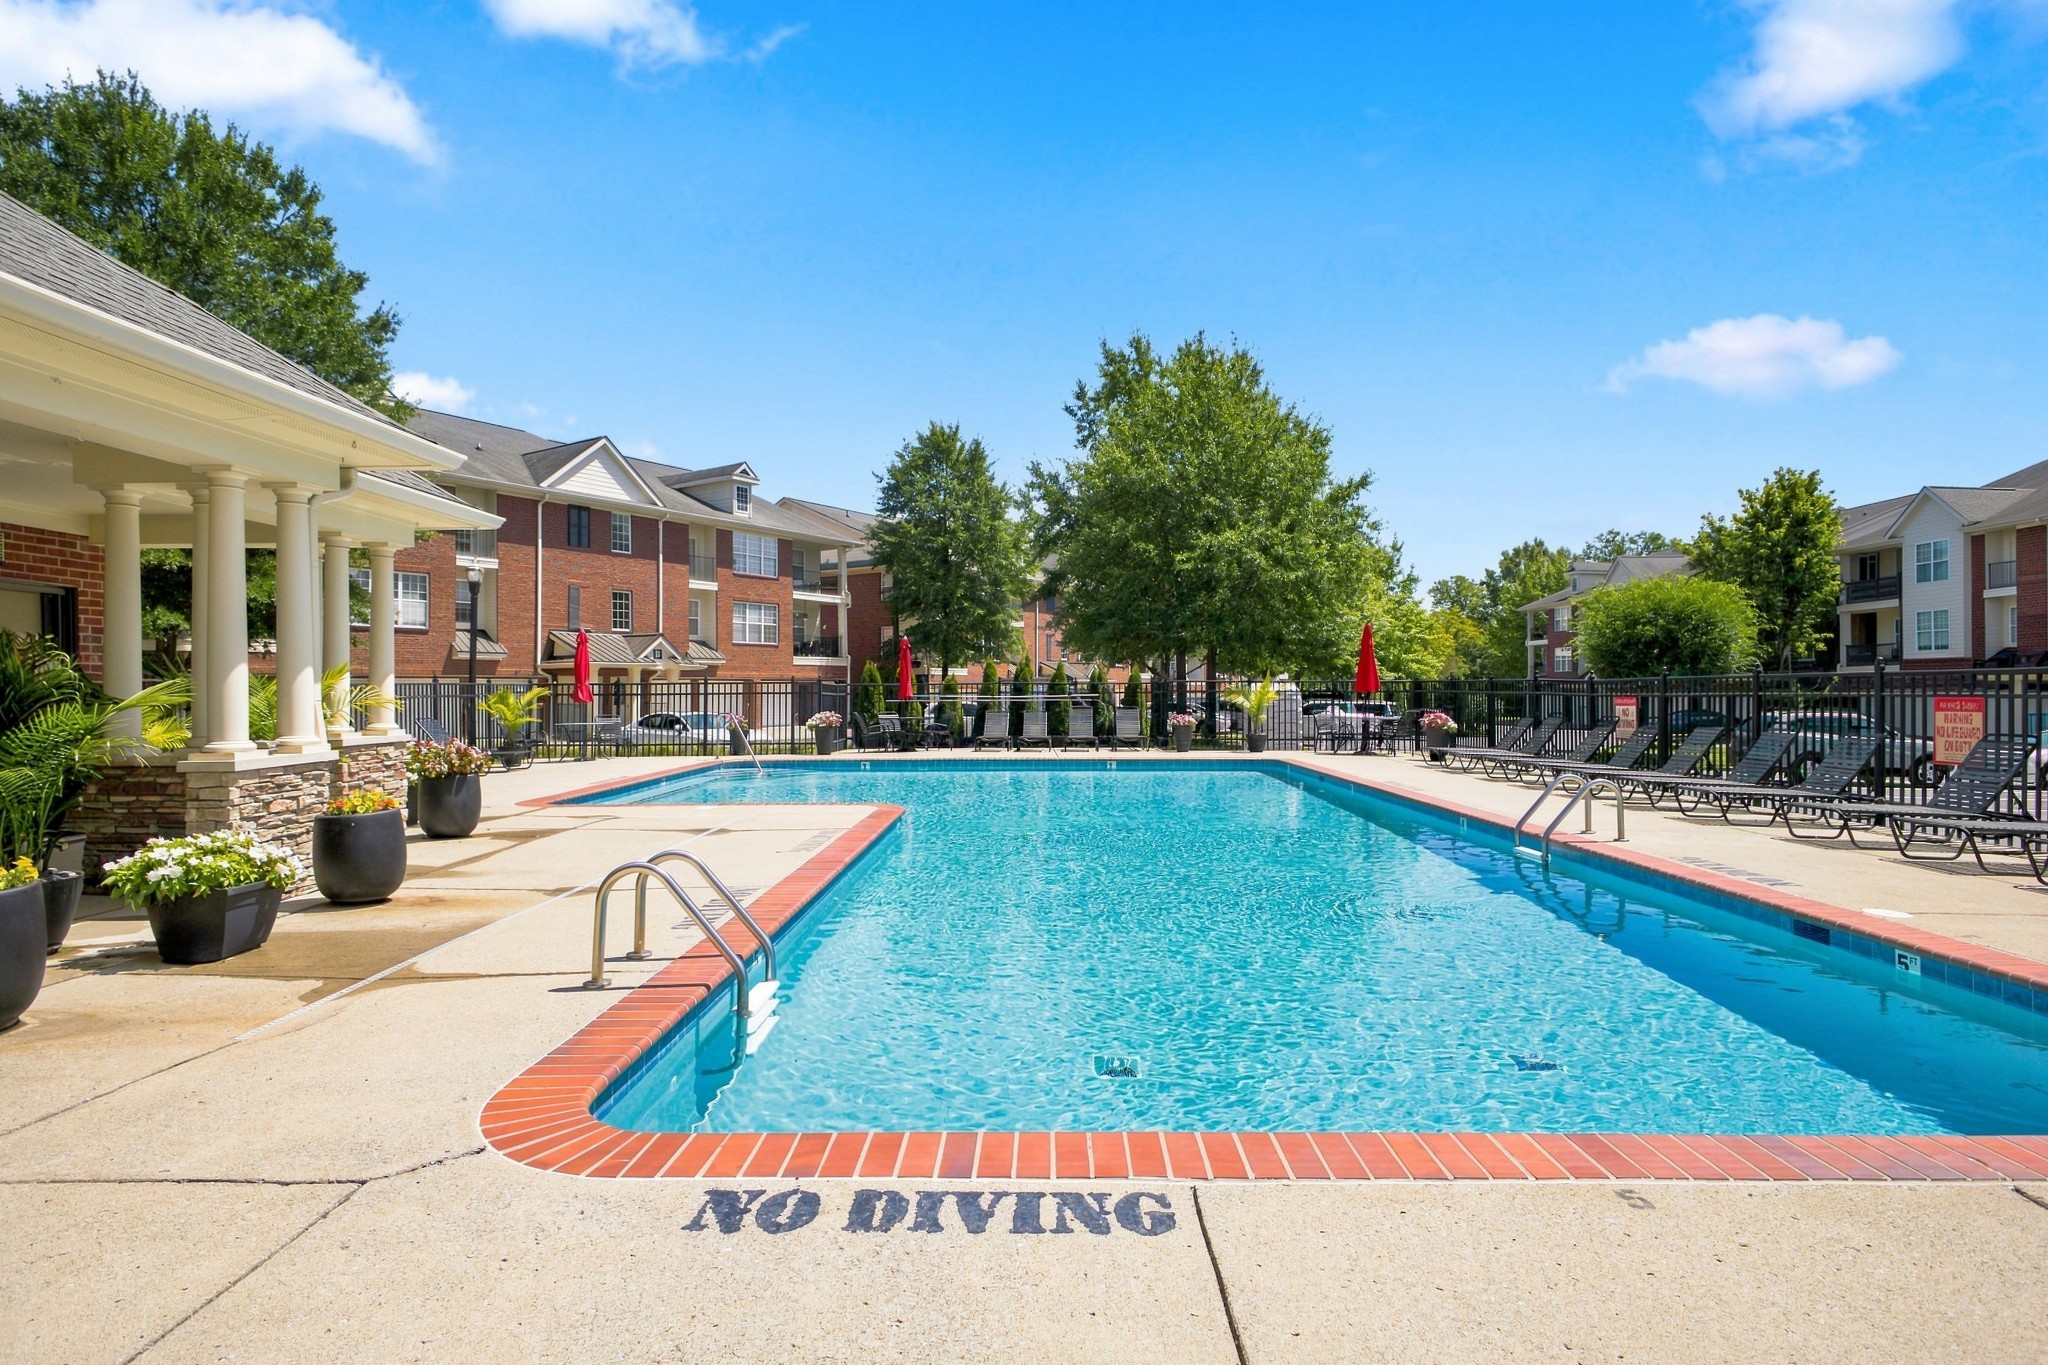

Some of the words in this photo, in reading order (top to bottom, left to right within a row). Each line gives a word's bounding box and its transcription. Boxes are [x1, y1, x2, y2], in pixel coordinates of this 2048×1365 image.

[1943, 713, 1973, 725] WARNING
[1936, 726, 1946, 738] NO
[1944, 740, 1954, 752] ON
[1955, 741, 1973, 753] DUTY
[1897, 952, 1910, 971] 5
[682, 1188, 821, 1234] NO
[842, 1189, 1177, 1236] DIVING
